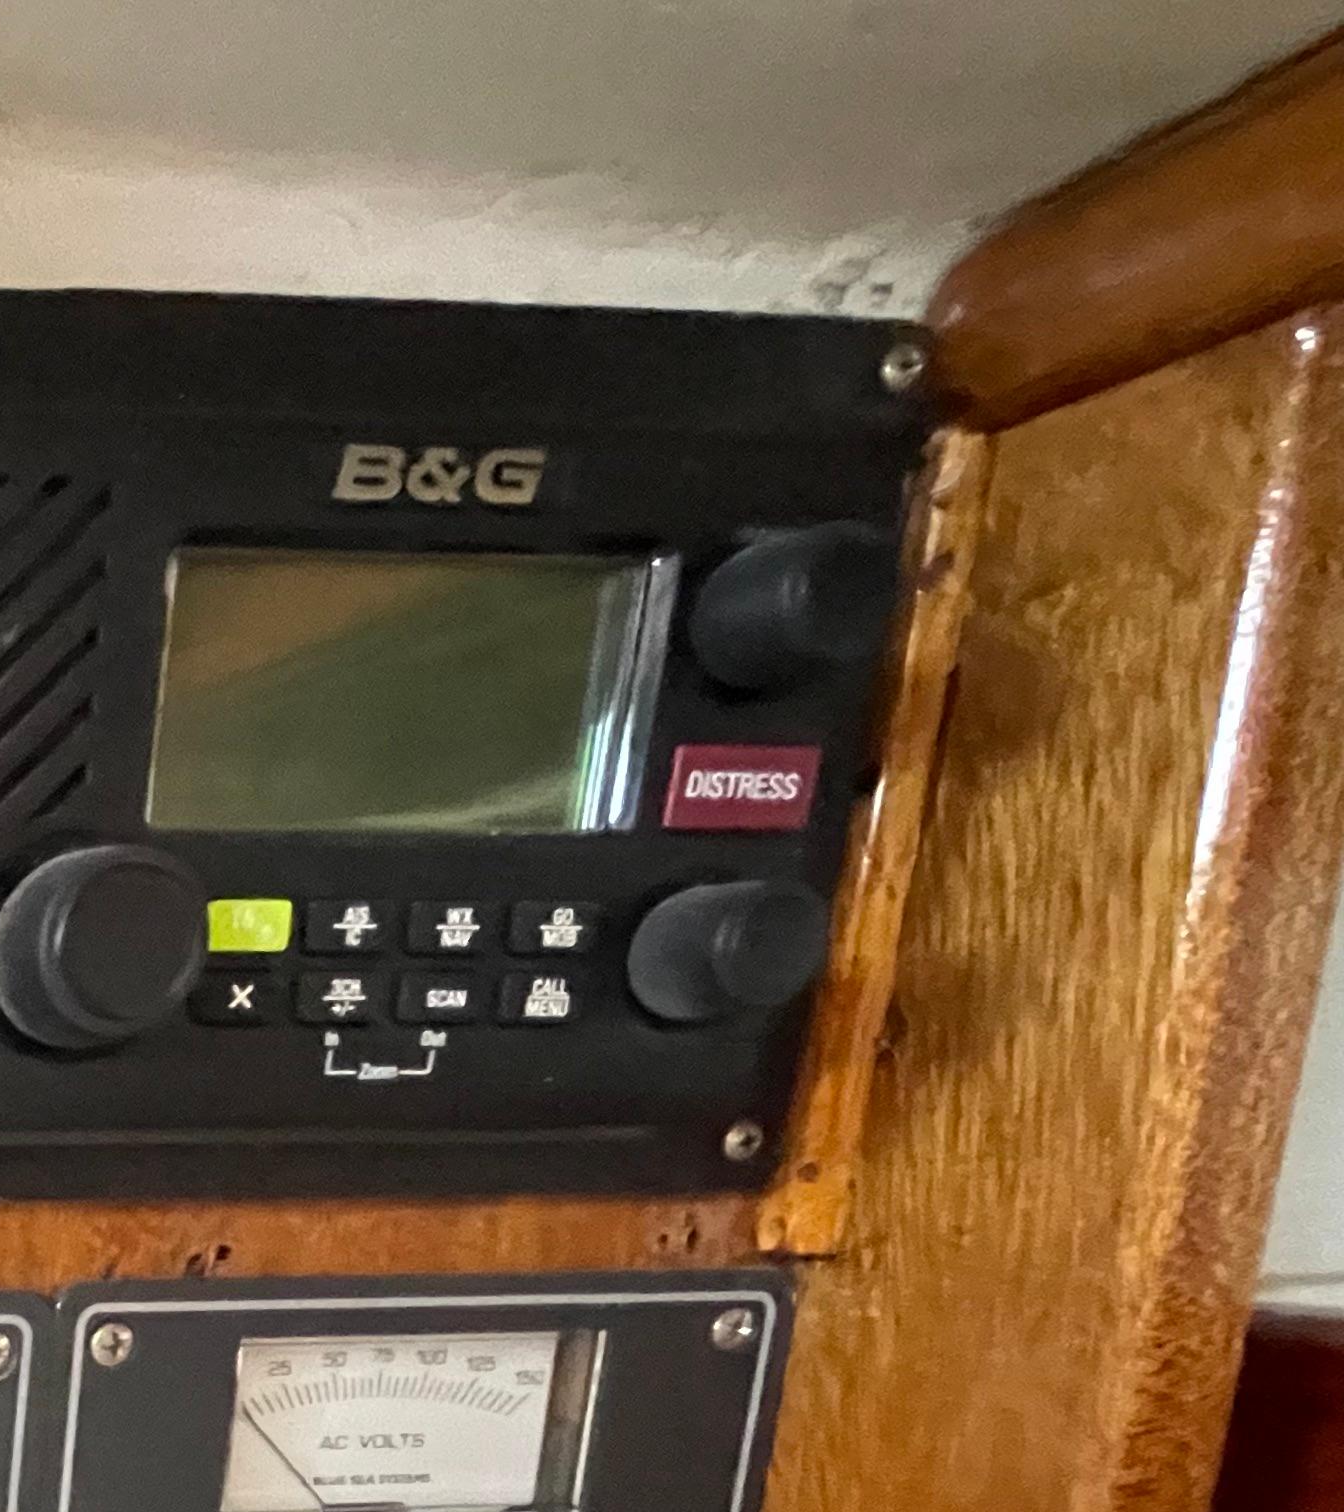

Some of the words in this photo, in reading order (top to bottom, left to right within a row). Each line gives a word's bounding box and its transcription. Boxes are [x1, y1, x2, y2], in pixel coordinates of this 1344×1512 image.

[332, 444, 545, 504] B&G
[685, 771, 799, 800] DISTRESS
[531, 978, 566, 997] CALL
[426, 990, 467, 1008] SCAN
[524, 997, 570, 1017] MENU
[320, 1435, 348, 1450] AC
[359, 1433, 425, 1449] VOLTS
